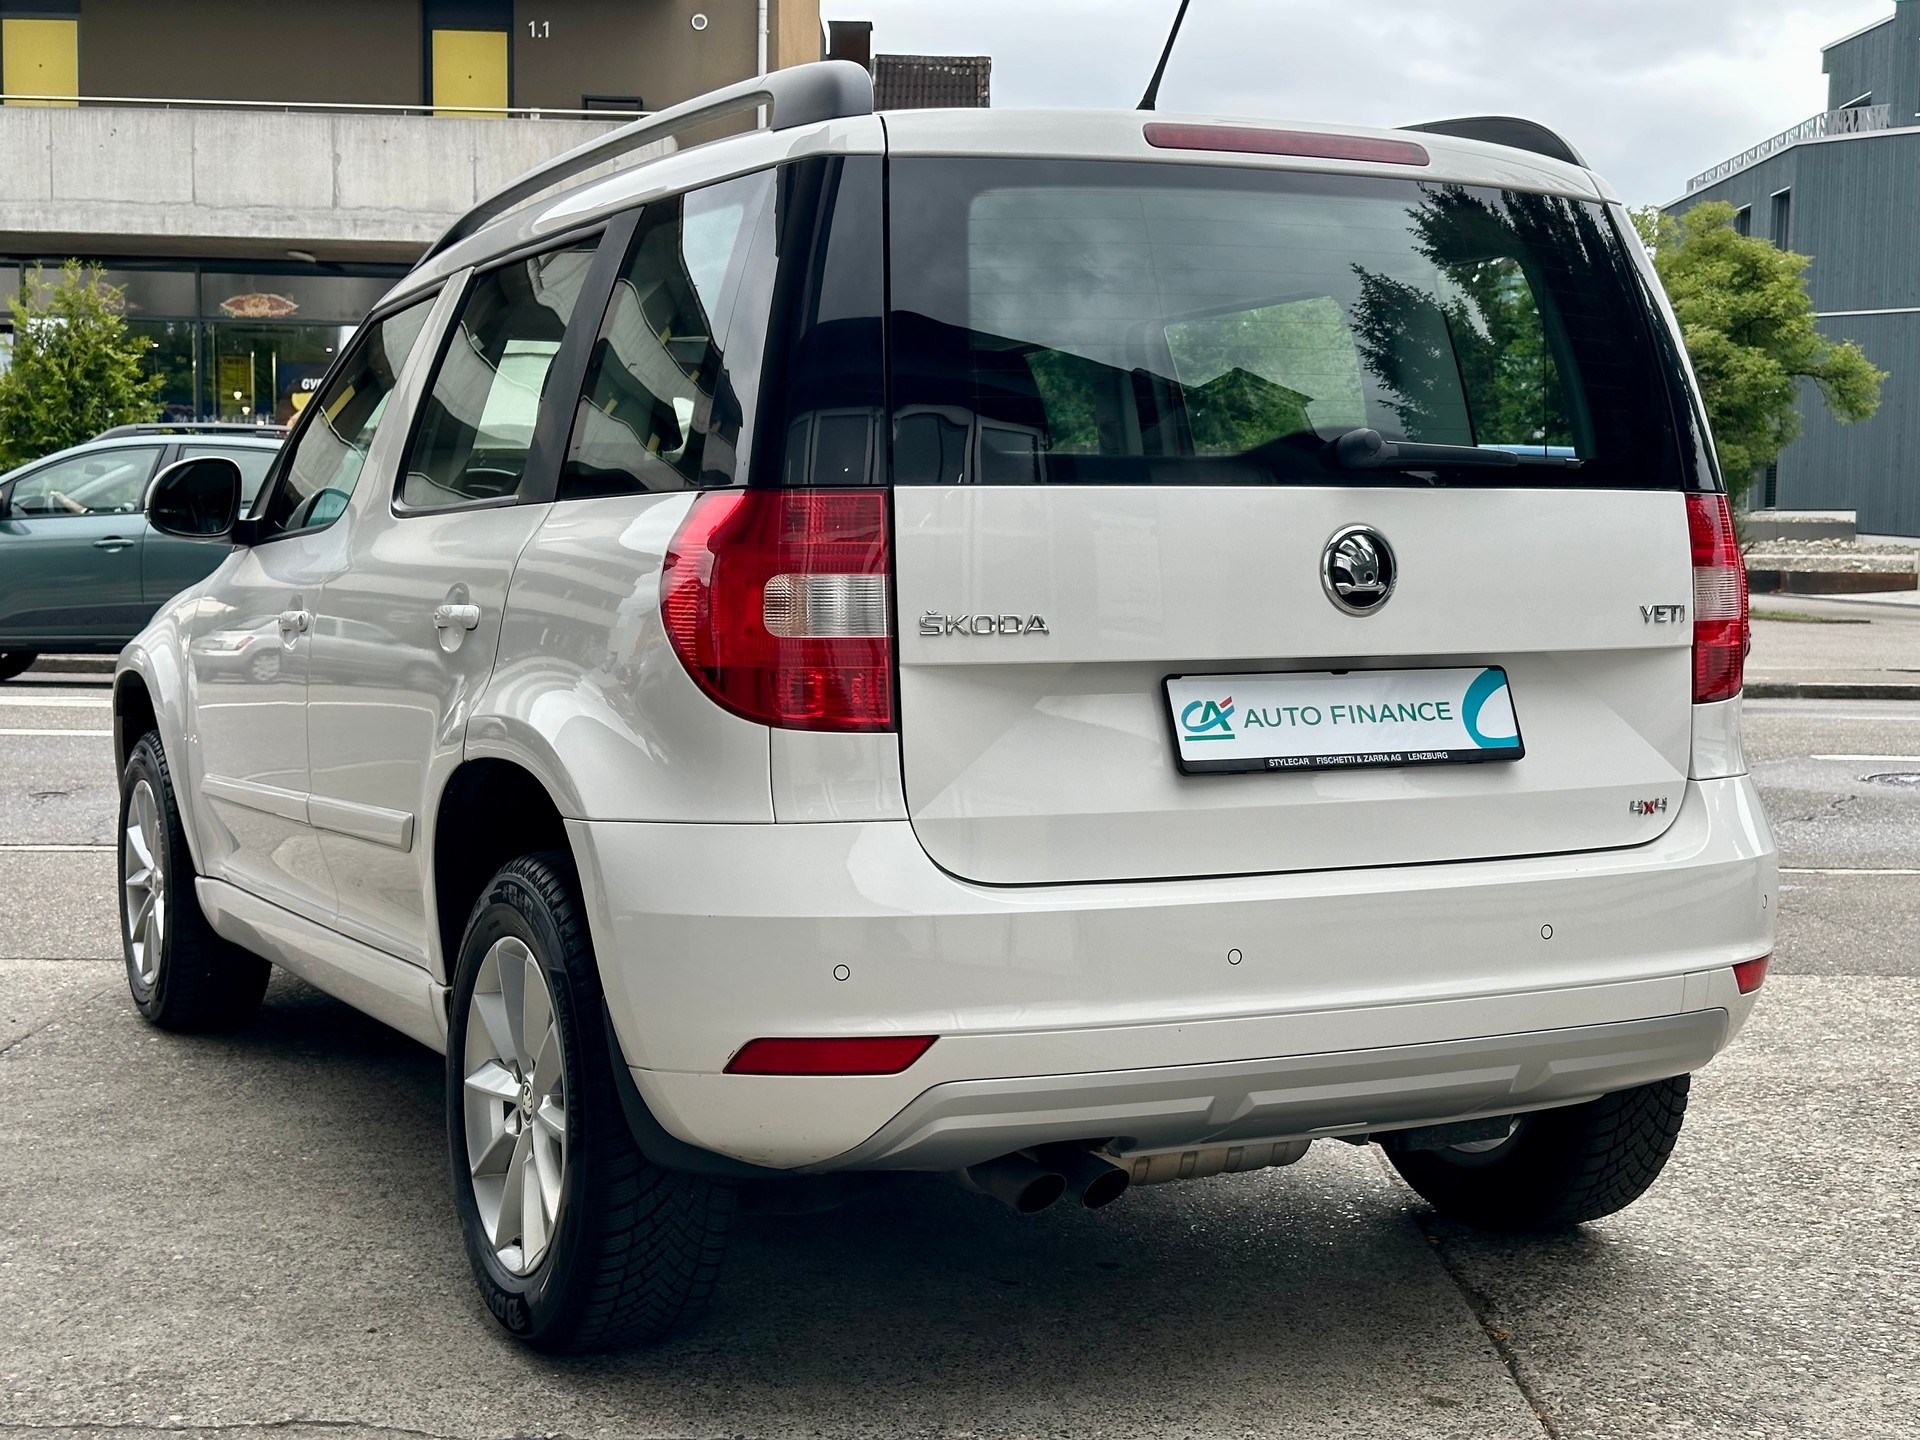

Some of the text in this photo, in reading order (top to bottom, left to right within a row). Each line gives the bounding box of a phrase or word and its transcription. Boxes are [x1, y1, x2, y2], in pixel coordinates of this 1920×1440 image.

[528, 20, 549, 38] 1.1
[919, 610, 1050, 636] ŠKODA
[1639, 604, 1685, 624] YETI
[1244, 701, 1453, 729] AUTO FINANCE
[1269, 751, 1449, 767] STYLECAR FISCHETTI & ZARRA AG LENZBURG
[1629, 797, 1668, 815] 4x4
